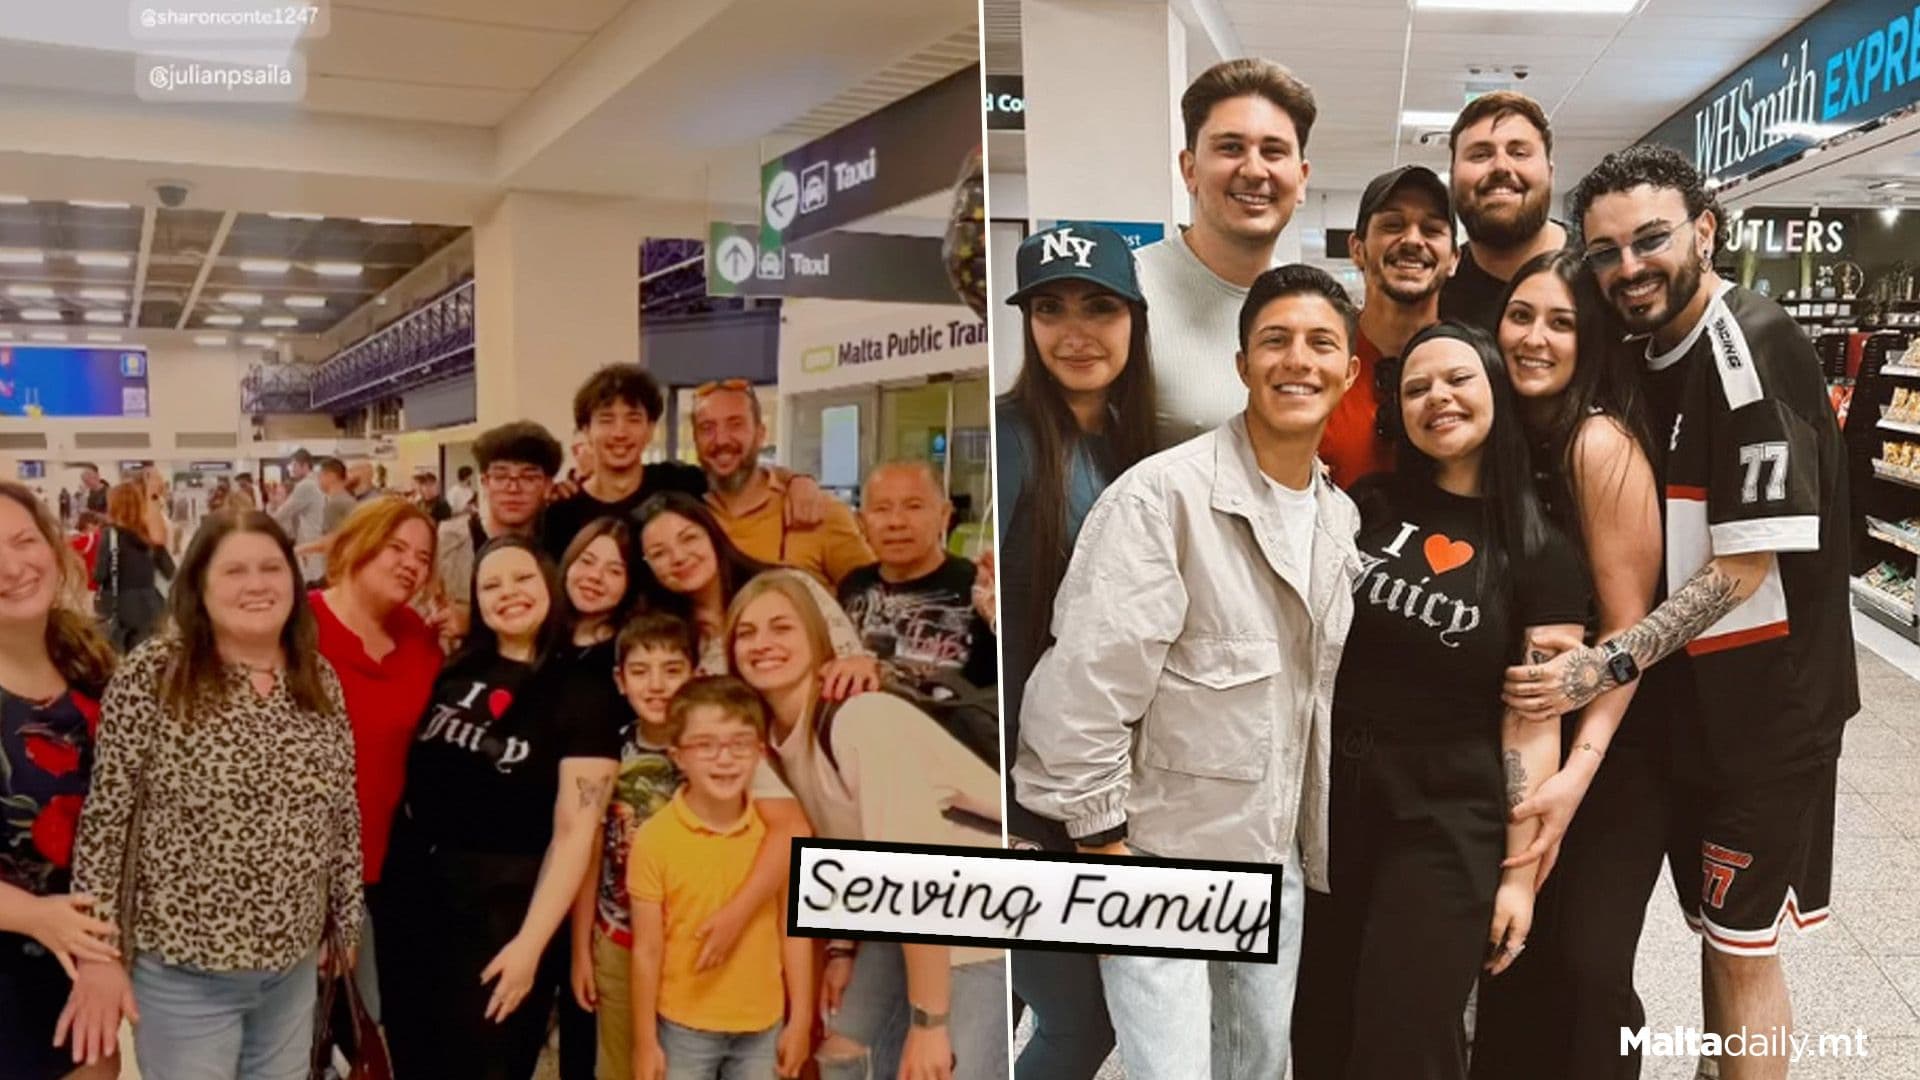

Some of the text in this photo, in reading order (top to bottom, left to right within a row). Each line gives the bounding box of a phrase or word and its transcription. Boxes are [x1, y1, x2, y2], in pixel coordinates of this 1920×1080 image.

[1695, 38, 1817, 182] WHSmith
[833, 147, 877, 192] Taxi
[1040, 228, 1097, 268] NY
[1726, 219, 1844, 253] UTLERS
[790, 253, 830, 276] Taxi
[837, 338, 884, 367] Malta
[887, 325, 943, 359] Public
[1739, 441, 1789, 504] 77
[1381, 521, 1420, 558] I
[419, 703, 531, 774] Juiy
